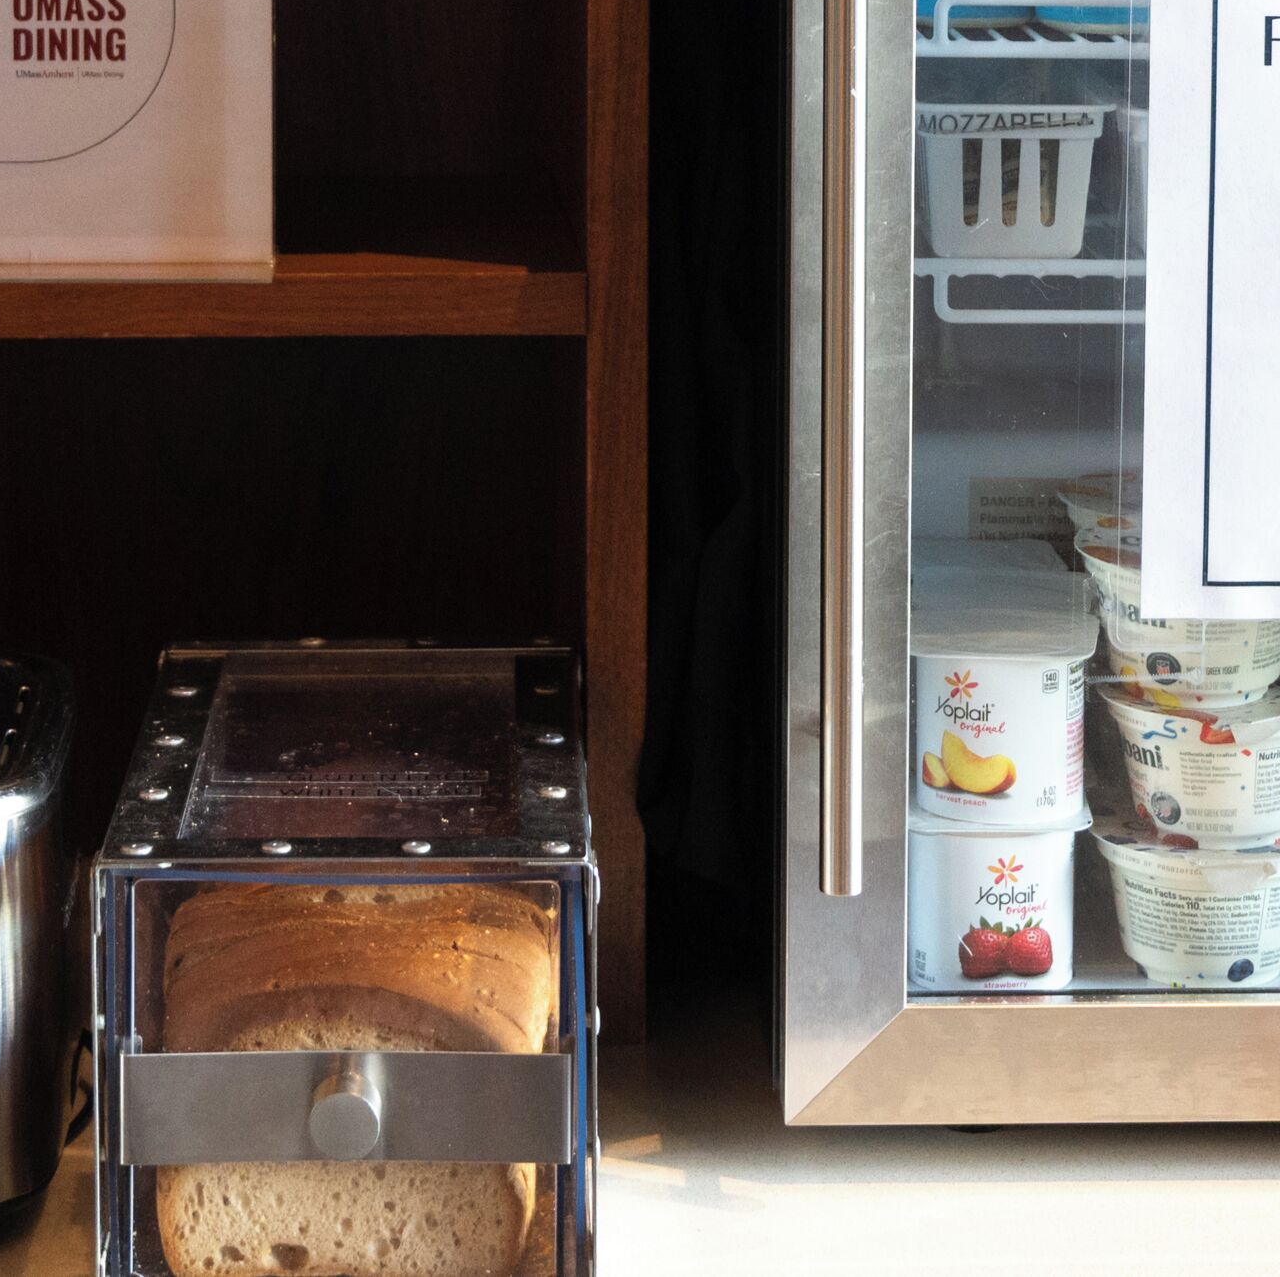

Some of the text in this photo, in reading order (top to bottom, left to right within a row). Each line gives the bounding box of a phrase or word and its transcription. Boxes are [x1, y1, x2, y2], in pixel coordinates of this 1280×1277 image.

[13, 27, 126, 62] DINING
[920, 112, 1093, 134] MOZZARELLA
[1045, 673, 1057, 682] 140
[935, 695, 991, 723] Yoplait
[936, 793, 987, 807] harvest peach
[976, 885, 1035, 911] Yoplait
[1125, 879, 1177, 900] Nutrition Facts
[984, 980, 1028, 989] strawberry
